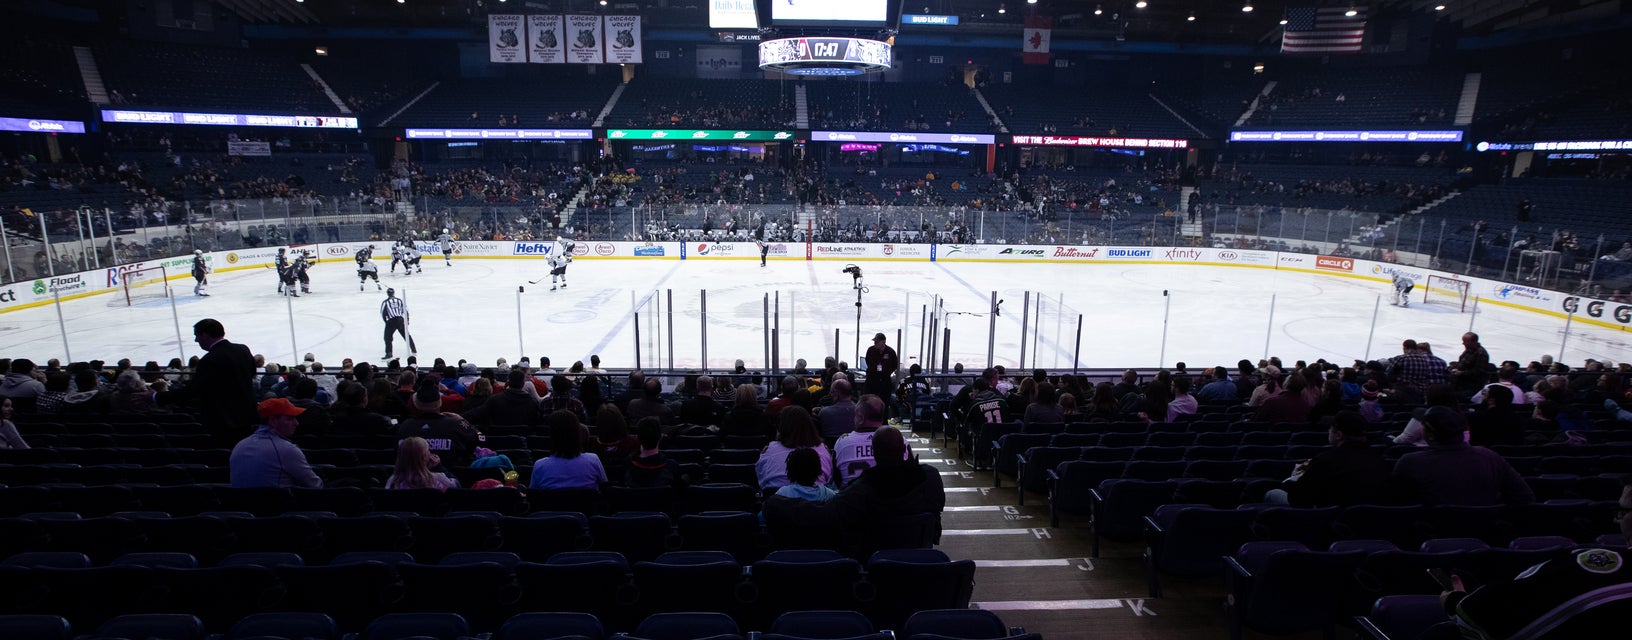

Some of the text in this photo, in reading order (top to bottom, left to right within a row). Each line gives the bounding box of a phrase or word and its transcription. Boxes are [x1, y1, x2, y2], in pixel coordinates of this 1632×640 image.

[735, 0, 752, 10] Hera
[814, 42, 838, 56] 17:47
[516, 243, 552, 255] Hefty
[711, 244, 734, 252] pepsi
[1053, 246, 1098, 257] Butternut
[1165, 248, 1202, 260] xfinity
[49, 274, 80, 288] Flood
[1562, 296, 1632, 323] G G G
[979, 401, 1000, 412] PARISE
[984, 409, 1002, 424] 11
[427, 438, 452, 451] SAULT
[959, 471, 974, 479] E
[976, 487, 991, 496] F
[1003, 505, 1020, 515] G
[1032, 528, 1052, 539] H
[1077, 558, 1095, 571] J
[1126, 599, 1158, 616] K
